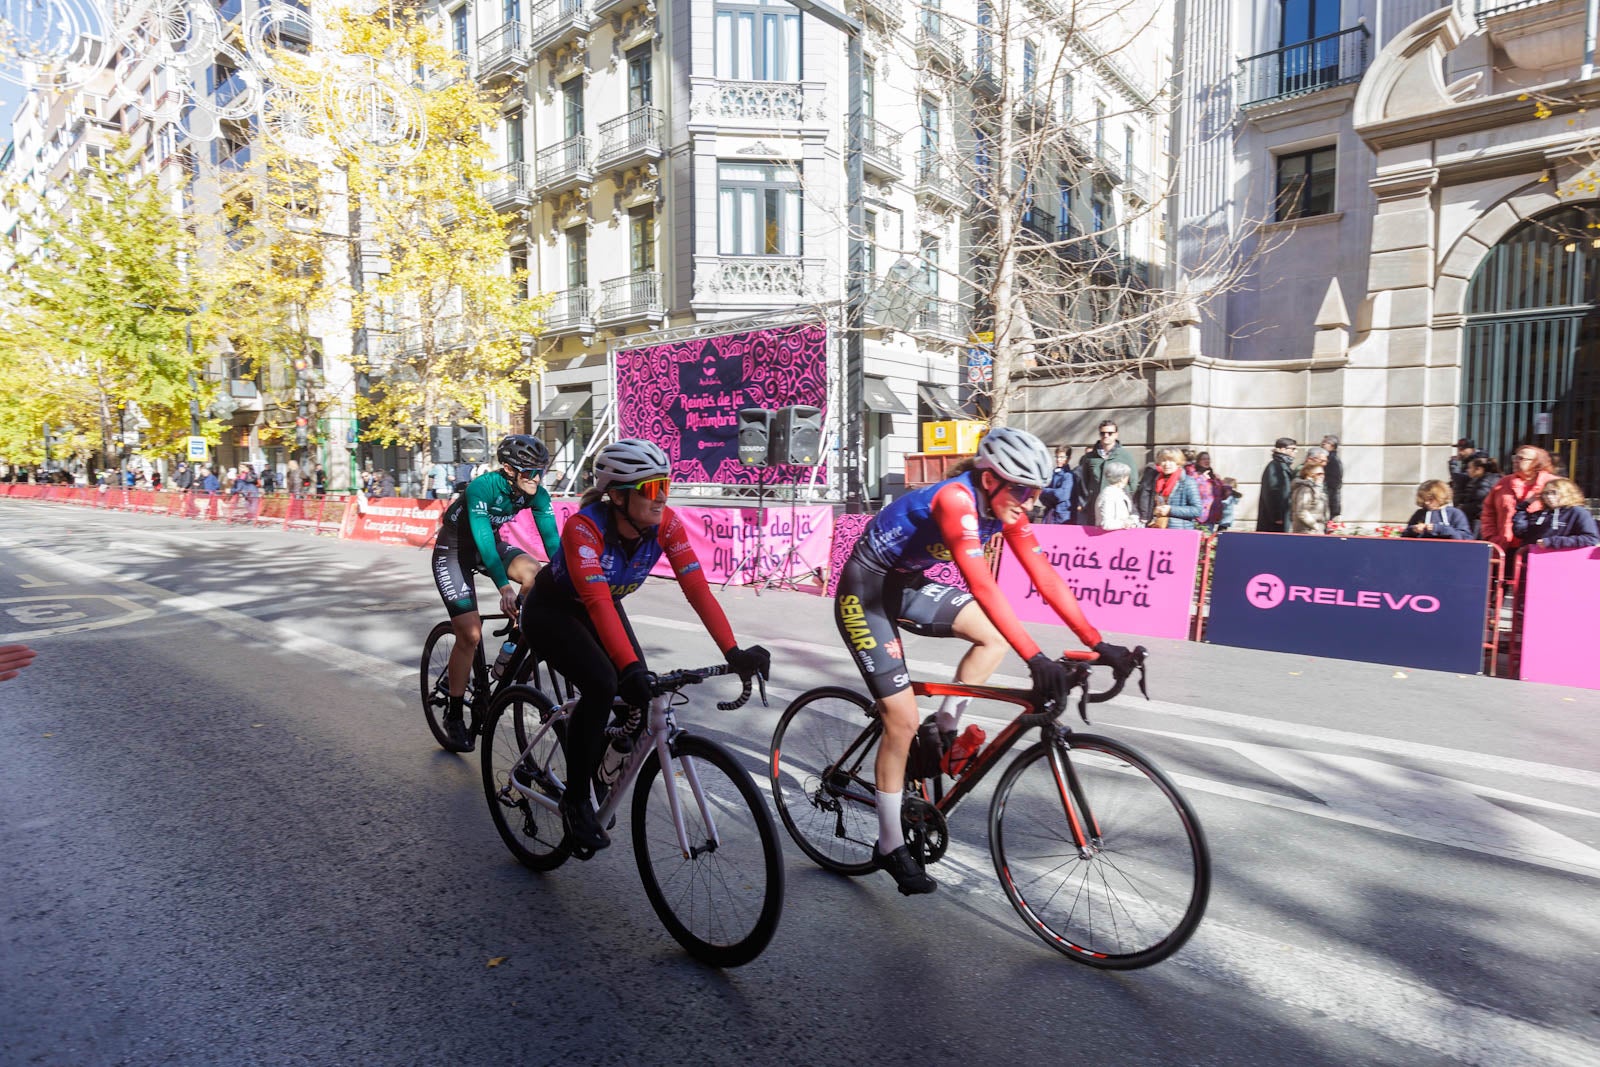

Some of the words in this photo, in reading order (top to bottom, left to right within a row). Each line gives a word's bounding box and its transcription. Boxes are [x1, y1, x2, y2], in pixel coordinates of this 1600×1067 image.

[717, 391, 732, 411] de
[1109, 548, 1141, 580] de
[1288, 585, 1441, 613] RELEVO
[839, 594, 878, 651] SEMAR
[858, 651, 875, 673] elite
